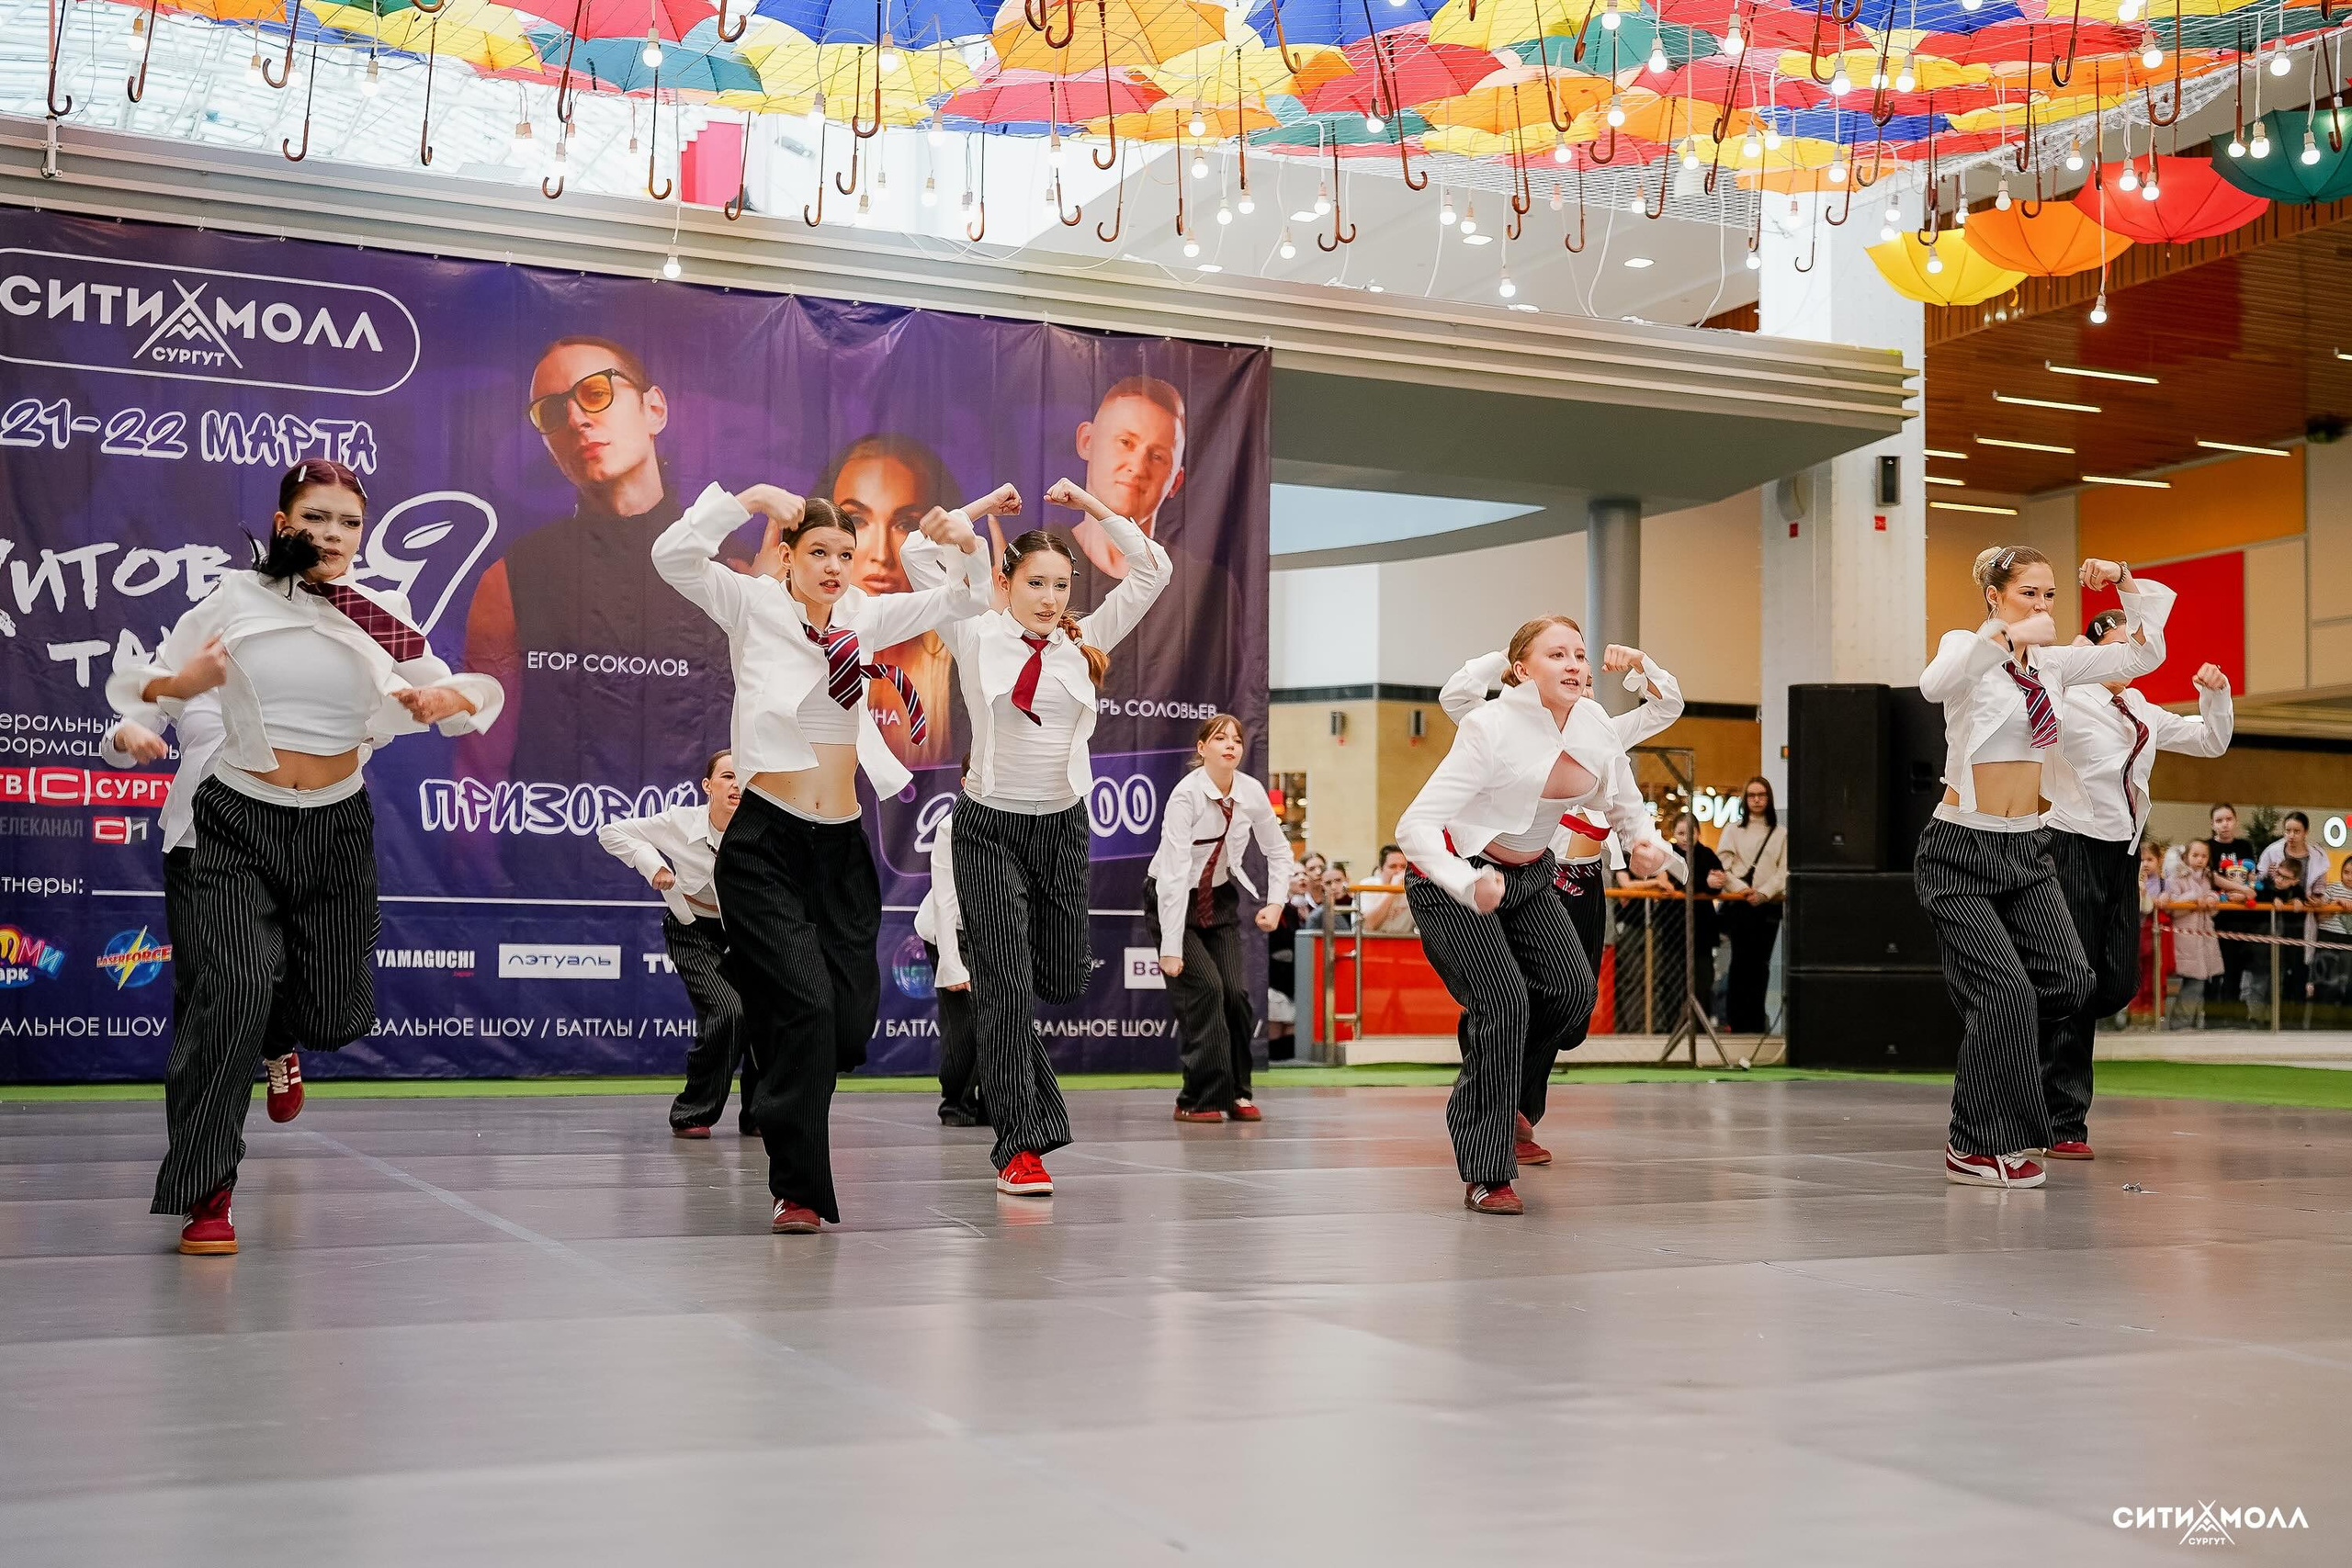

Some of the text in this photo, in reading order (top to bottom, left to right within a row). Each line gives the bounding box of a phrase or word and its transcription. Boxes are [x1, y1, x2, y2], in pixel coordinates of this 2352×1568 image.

[0, 275, 384, 353] СИТИ МОЛЛ
[152, 345, 226, 367] СУРГУТ
[0, 398, 378, 475] 21-22 МАРТА
[527, 650, 690, 677] ЕГОР СОКОЛОВ
[1125, 699, 1218, 720] СОЛОВЬЕВ
[96, 944, 174, 968] LASERFORCE
[376, 949, 476, 969] YAMAGUCHI
[107, 1016, 167, 1037] ШОУ
[481, 1017, 535, 1037] ШОУ
[556, 1018, 634, 1037] БАТТЛЫ
[885, 1019, 941, 1038] БАТТЛ
[1121, 1018, 1167, 1038] ШОУ
